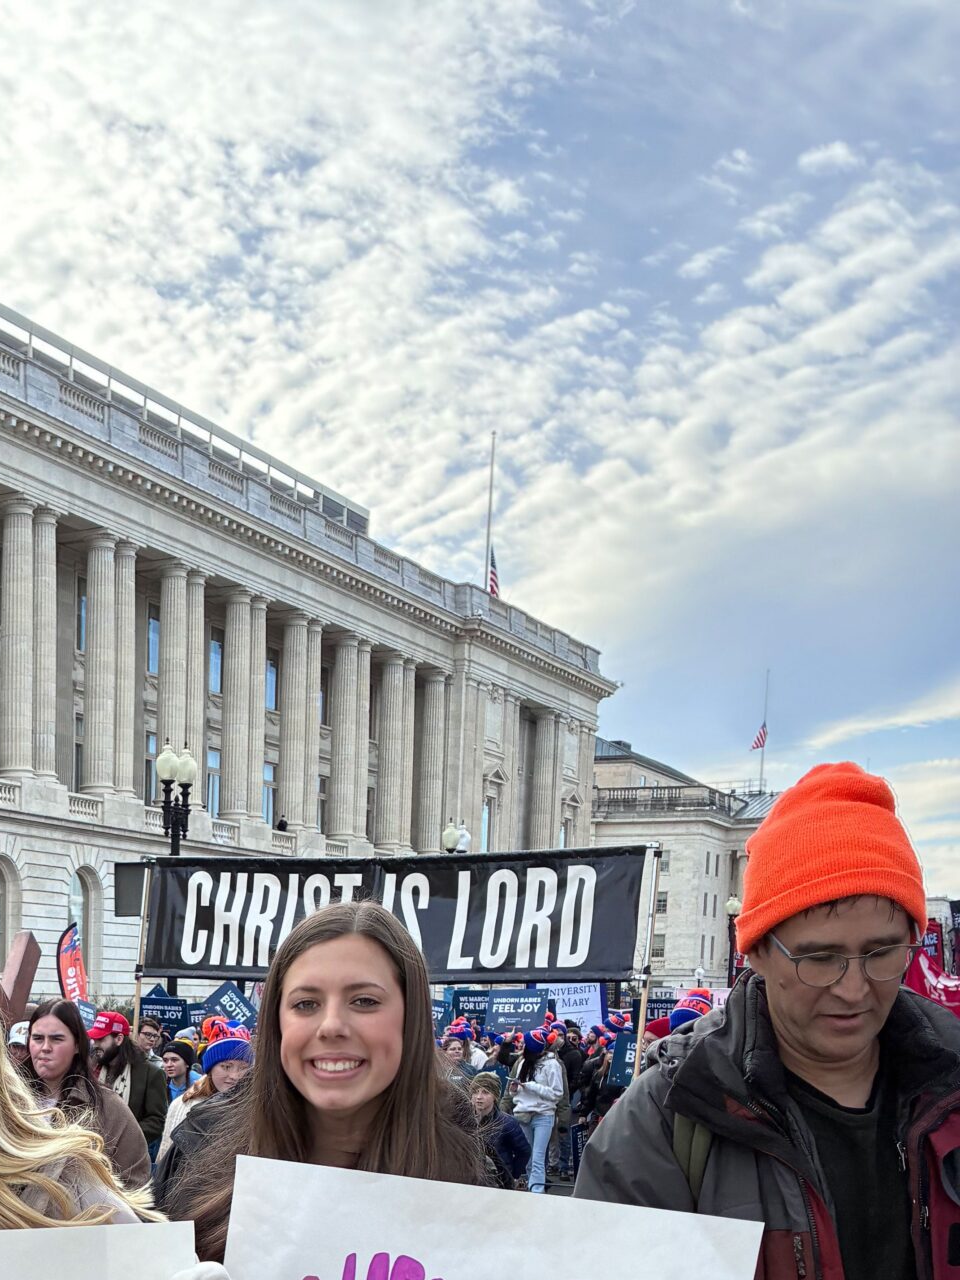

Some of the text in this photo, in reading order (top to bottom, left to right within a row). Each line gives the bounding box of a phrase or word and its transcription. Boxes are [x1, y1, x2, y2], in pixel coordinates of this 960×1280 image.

[180, 870, 362, 966] CHRI
[447, 865, 597, 969] LORD
[228, 990, 240, 1004] LOVE
[550, 985, 598, 997] NIVERSITY
[143, 1010, 182, 1019] FEEL JOY
[220, 994, 247, 1022] BOTH
[492, 1004, 540, 1013] FEEL JOY
